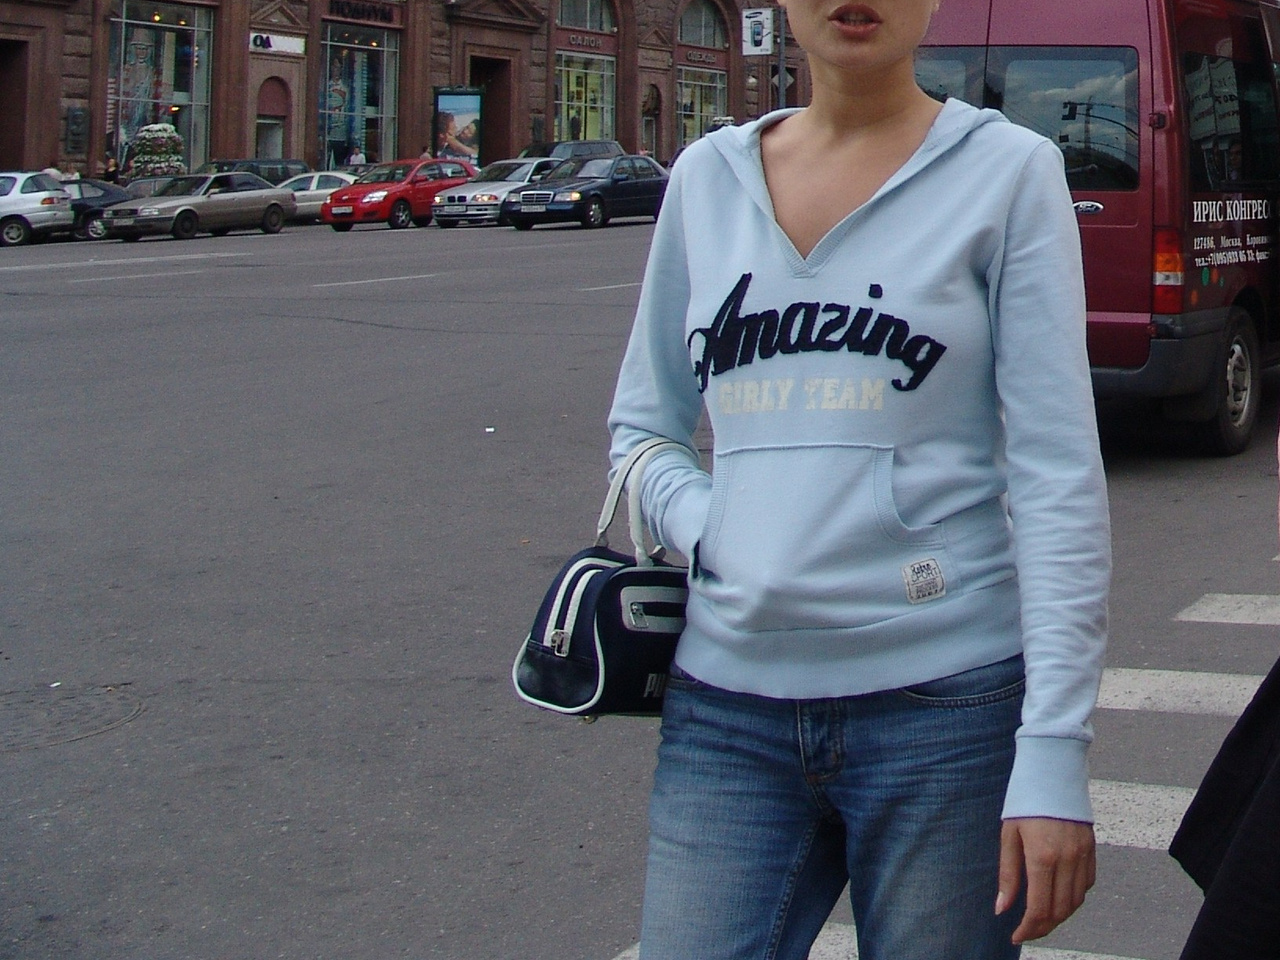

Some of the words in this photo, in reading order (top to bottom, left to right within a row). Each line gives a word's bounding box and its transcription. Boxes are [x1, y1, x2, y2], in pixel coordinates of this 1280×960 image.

[569, 34, 602, 48] САЛОН
[1193, 200, 1223, 222] ИРИС
[1226, 199, 1270, 220] КОНГРЕС
[1220, 235, 1242, 248] Москва,
[687, 272, 947, 394] Amazing
[718, 378, 794, 415] GIRLY
[804, 378, 887, 411] TEAM
